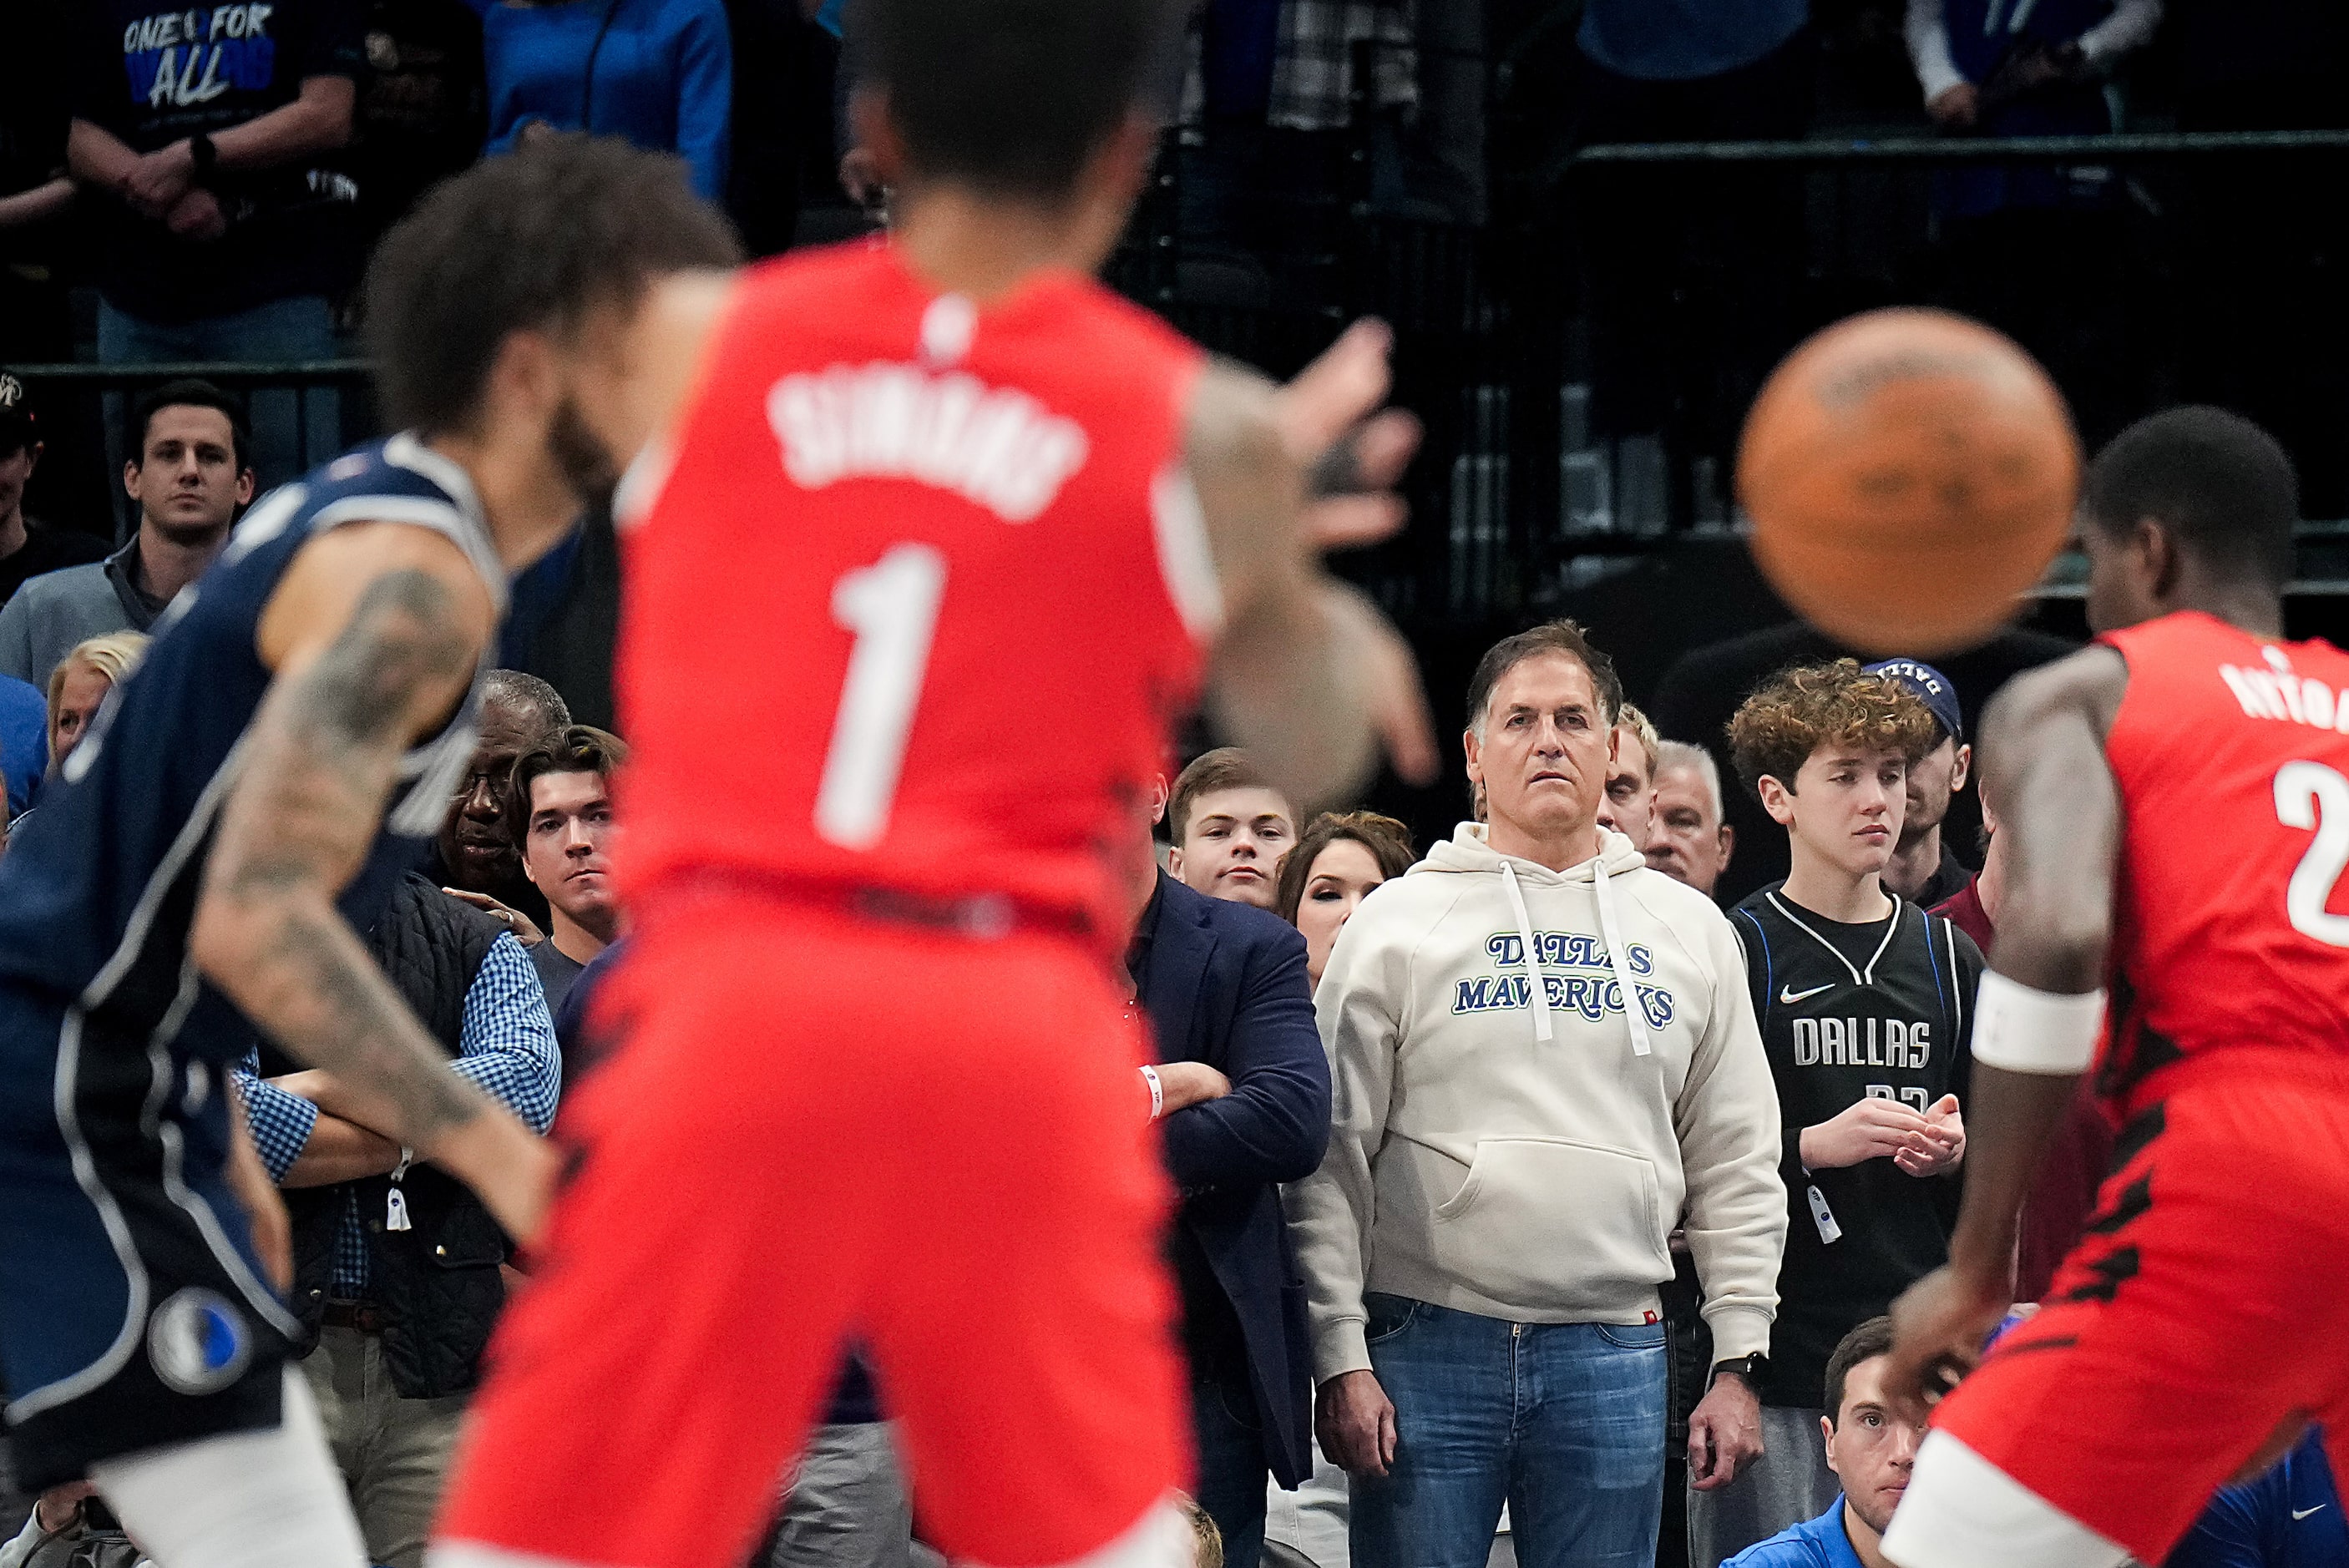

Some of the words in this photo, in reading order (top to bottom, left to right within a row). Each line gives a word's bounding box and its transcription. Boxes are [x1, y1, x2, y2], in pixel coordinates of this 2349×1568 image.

[124, 12, 183, 53] ONE
[209, 3, 274, 44] FOR
[148, 43, 230, 109] ALL
[813, 539, 949, 852] 1
[2273, 760, 2349, 948] 2
[1451, 974, 1676, 1031] MAVERICKS
[1792, 1017, 1931, 1070] DALLAS
[1812, 1190, 1821, 1201] VIP
